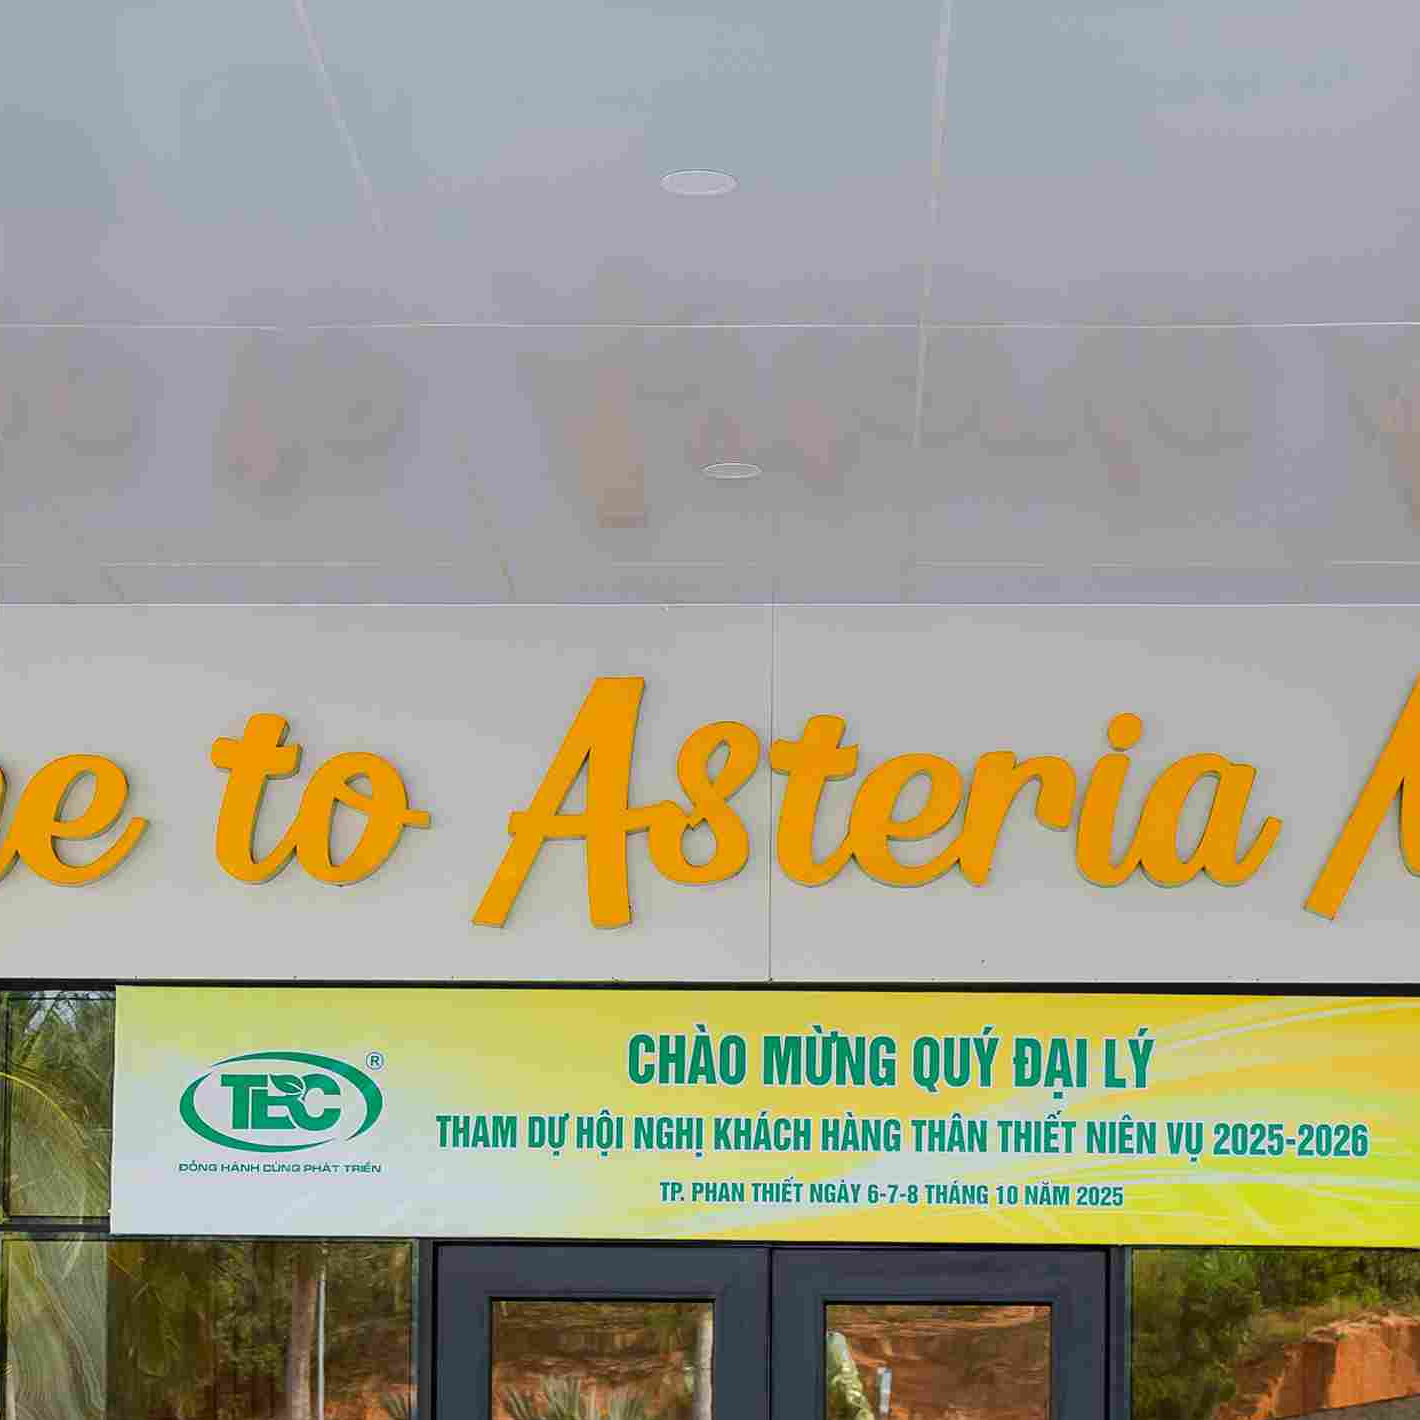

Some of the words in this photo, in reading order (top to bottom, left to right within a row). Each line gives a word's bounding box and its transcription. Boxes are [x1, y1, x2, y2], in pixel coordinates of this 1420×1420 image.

[210, 712, 432, 887] to
[470, 675, 1283, 929] Asteria
[627, 1024, 747, 1086] CHÀO
[762, 1025, 897, 1088] MỪNG
[912, 1026, 1000, 1093] QUÝ
[1012, 1037, 1089, 1100] ĐẠI
[1105, 1028, 1156, 1089] LÝ
[436, 1114, 518, 1149] THAM
[529, 1112, 570, 1157] DỰ
[576, 1109, 624, 1157] HỘI
[634, 1115, 705, 1157] NGHỊ
[713, 1111, 812, 1152] KHÁCH
[821, 1113, 902, 1153] HÀNG
[912, 1112, 990, 1154] THÂN
[997, 1110, 1078, 1155] THIẾT
[1085, 1114, 1158, 1156] NIÊN
[1165, 1121, 1205, 1162] VỤ
[1213, 1122, 1370, 1158] 2025-2026
[660, 1181, 686, 1203] TP.
[692, 1181, 746, 1203] PHAN
[751, 1177, 804, 1204] THIẾT
[809, 1178, 862, 1204] NGÀY
[868, 1182, 920, 1206] 6-7-8
[925, 1178, 990, 1207] THÁNG
[996, 1183, 1018, 1206] 10
[1024, 1179, 1072, 1207] NĂM
[1077, 1184, 1125, 1207] 2025
